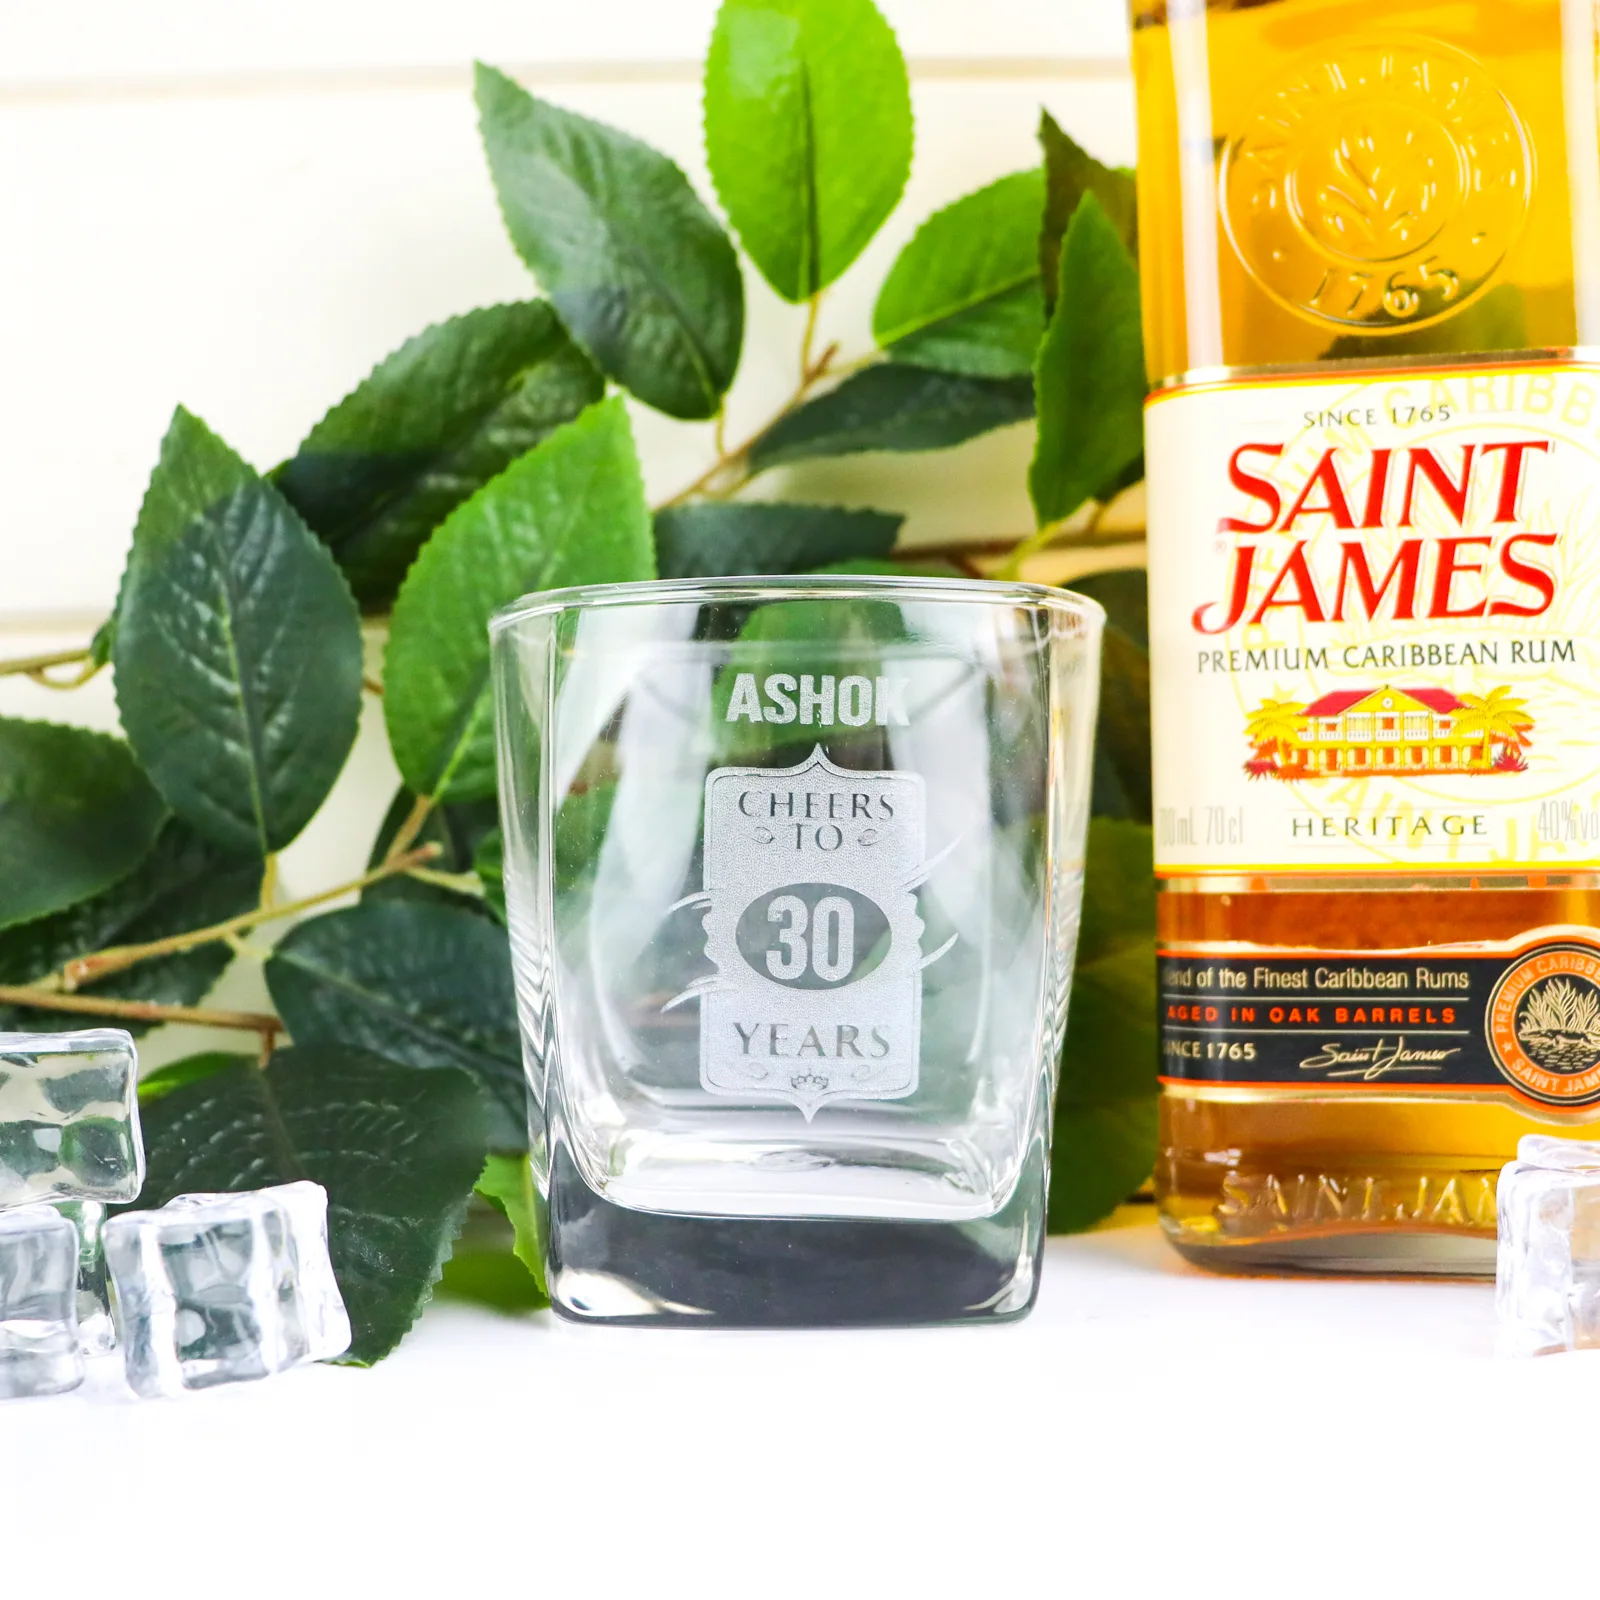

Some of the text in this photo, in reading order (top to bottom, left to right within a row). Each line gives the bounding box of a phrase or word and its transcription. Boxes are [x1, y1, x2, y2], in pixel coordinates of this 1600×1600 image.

[1309, 255, 1459, 318] 1765
[1303, 405, 1450, 429] SINCE 1765
[1217, 441, 1553, 533] SAINT
[1192, 533, 1559, 634] JAMES
[1198, 639, 1576, 673] PREMIUM CARIBBEAN RUM
[725, 673, 910, 727] ASHOK
[738, 790, 894, 820] CHEERS
[787, 822, 843, 851] TO
[1293, 814, 1487, 837] HERITAGE
[766, 895, 854, 982] 30
[1196, 967, 1214, 988] of
[1219, 967, 1247, 988] the
[1253, 966, 1308, 988] Finest
[1315, 966, 1408, 989] Caribbean
[1416, 967, 1469, 989] Rums
[1167, 1005, 1456, 1024] AGED IN OAK BARRELS
[1496, 967, 1535, 1034] PREMIUM
[733, 1022, 891, 1058] YEARS
[1207, 1042, 1257, 1060] 1765
[1511, 1057, 1560, 1092] SAINT
